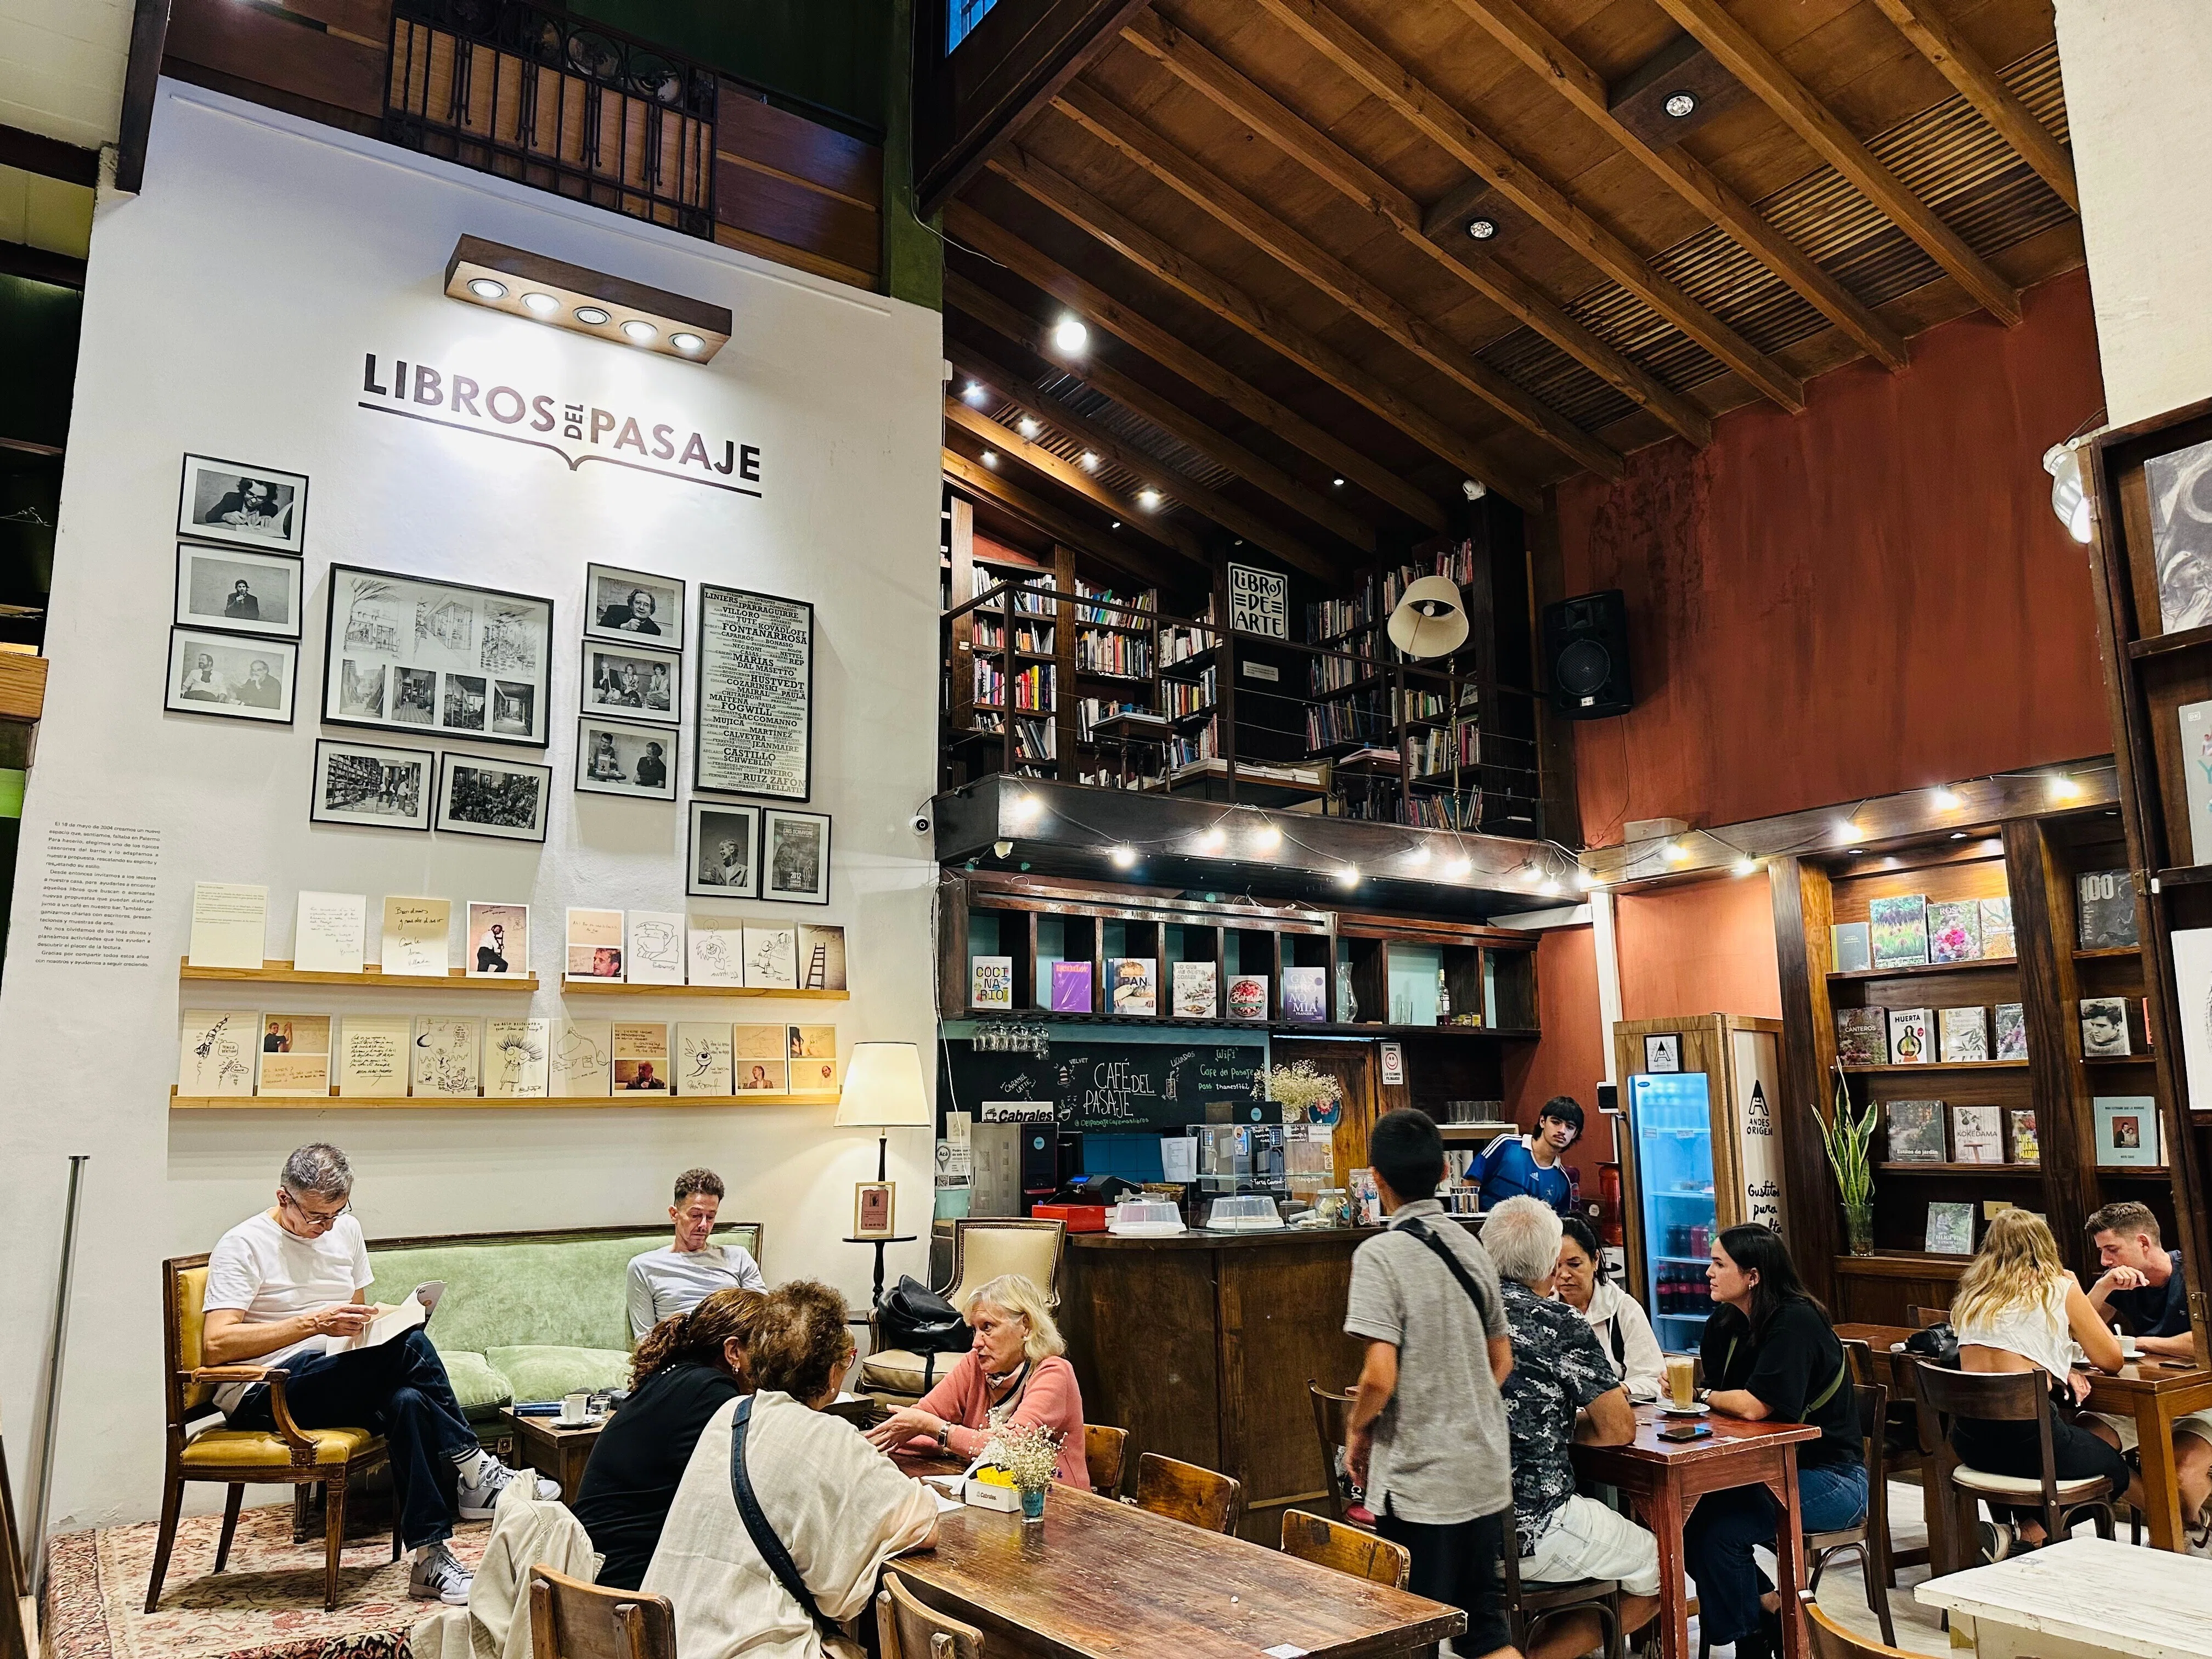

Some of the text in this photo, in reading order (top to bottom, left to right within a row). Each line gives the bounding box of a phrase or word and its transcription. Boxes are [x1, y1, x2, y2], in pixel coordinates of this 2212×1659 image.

[364, 353, 760, 483] LIBROS DEL PASAJE
[705, 592, 738, 603] LINIERS
[1248, 594, 1271, 614] DE
[722, 607, 760, 618] VILLORO
[738, 602, 798, 619] IPARRAGUIRRE
[736, 616, 757, 625] TUTE
[1235, 611, 1284, 636] ARTE
[721, 630, 754, 641] CAPARRÓS
[722, 623, 808, 645] FONTANARROSA
[758, 623, 806, 637] KOVADLOFF
[732, 643, 762, 652] NEGRONI
[765, 639, 793, 647] BONASSO
[755, 664, 794, 676] MASETTO
[726, 679, 778, 692] COZARINSKI
[751, 674, 804, 689] HUSTVEDT
[721, 690, 762, 701] CHITARRONI
[737, 686, 770, 697] MAIRAL
[781, 691, 806, 700] PAULA
[709, 693, 749, 705] MAITENA
[721, 702, 772, 716] FOGWILL
[713, 716, 744, 726] MUJICA
[738, 713, 797, 727] SACCOMANNO
[723, 730, 766, 741] CALVEYRA
[752, 741, 799, 753] JEANMAIRE
[724, 747, 776, 761] CASTILLO
[724, 755, 773, 767] SCHWEBLIN
[742, 773, 805, 788] RUIZ ZAFÓN
[766, 783, 805, 794] BELLATIN
[2080, 874, 2114, 904] 100
[1939, 906, 1968, 915] ROSAS
[976, 967, 1009, 978] COCI
[984, 978, 1001, 989] NA
[1122, 977, 1148, 986] PAN
[1290, 974, 1314, 984] GAS
[980, 990, 1003, 1000] RIO
[1289, 992, 1306, 1003] NO
[1894, 1014, 1921, 1023] HUERTA
[1094, 1058, 1155, 1094] CAFÉ DEL
[1004, 1073, 1028, 1093] CARAMEL
[1015, 1079, 1032, 1093] LATTE
[1083, 1089, 1134, 1119] PASAJE
[998, 1109, 1053, 1122] Cabrales
[1749, 1118, 1770, 1127] ANDES
[1747, 1126, 1773, 1136] ORIGEN
[1748, 1180, 1780, 1198] Gustitos
[1753, 1204, 1778, 1221] pura
